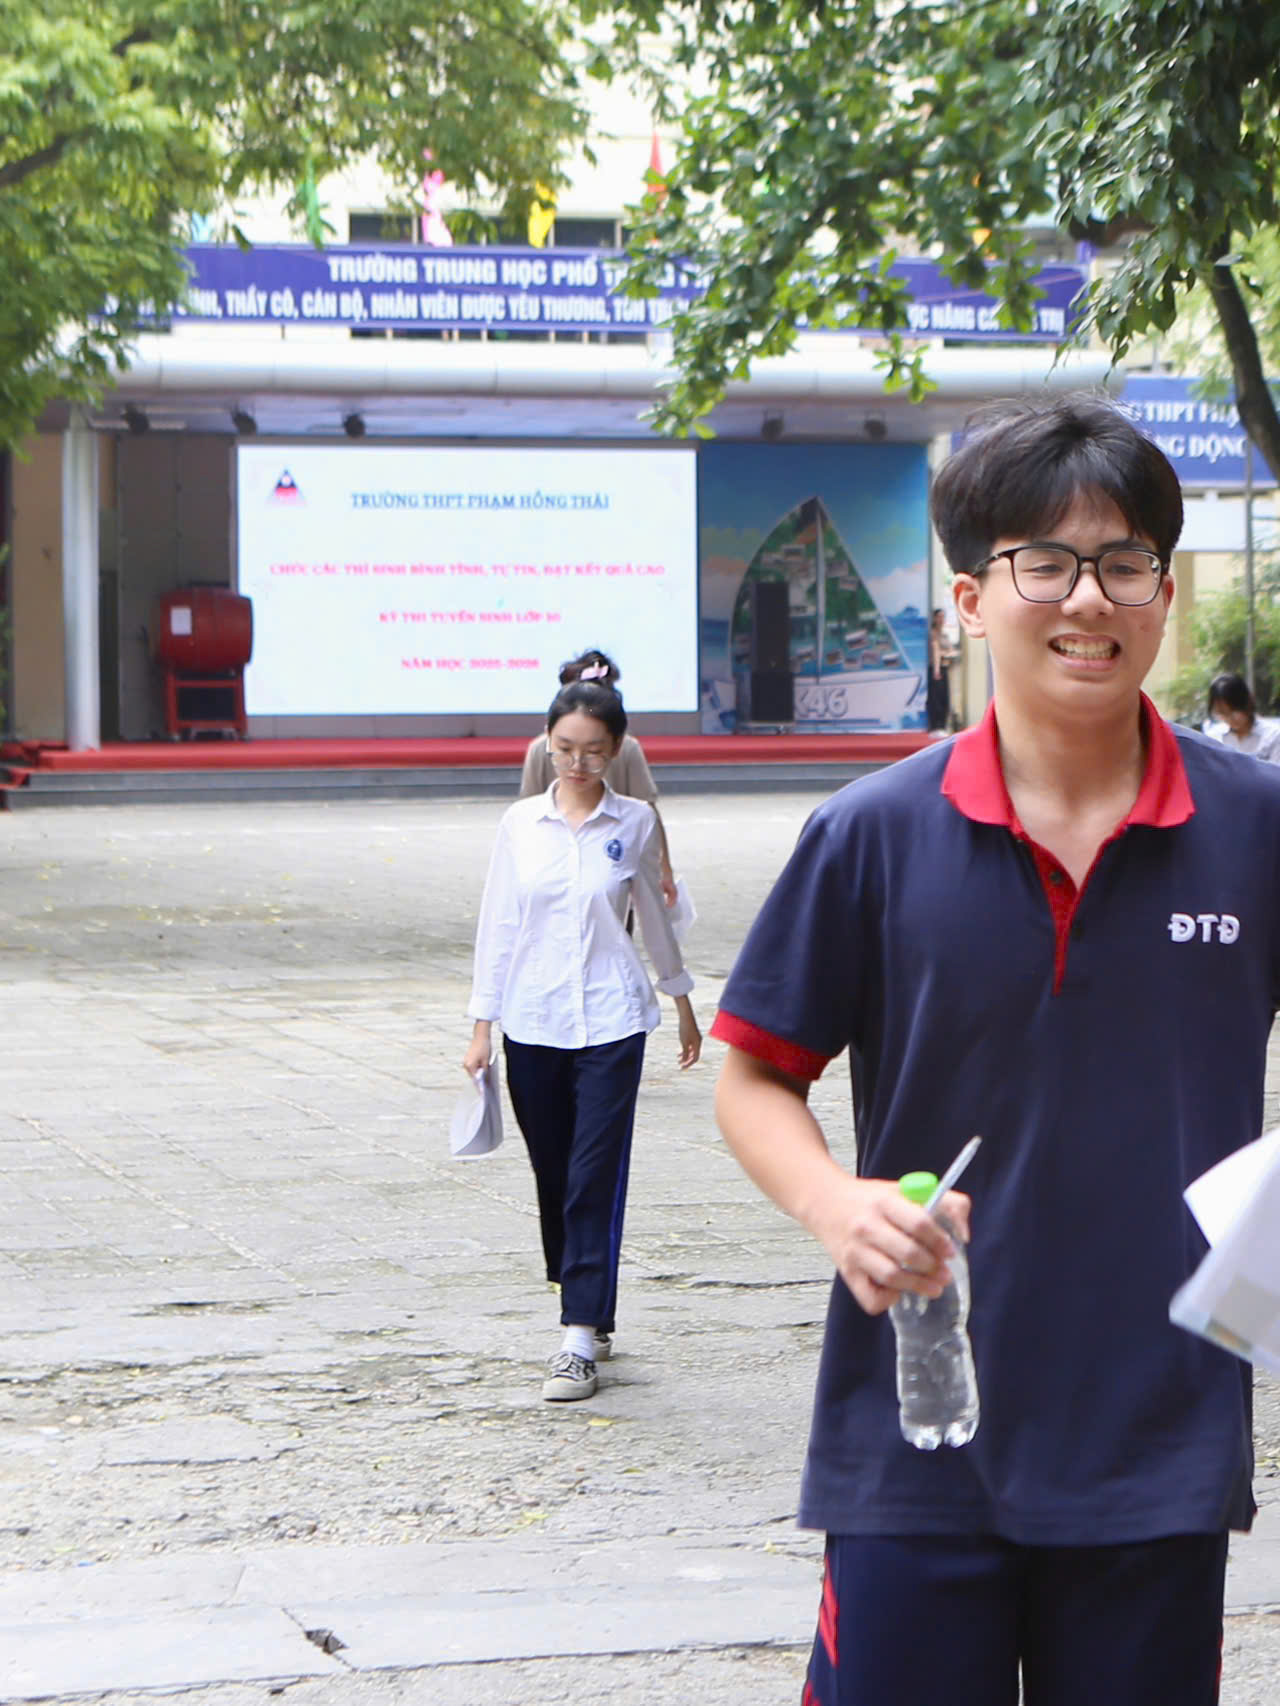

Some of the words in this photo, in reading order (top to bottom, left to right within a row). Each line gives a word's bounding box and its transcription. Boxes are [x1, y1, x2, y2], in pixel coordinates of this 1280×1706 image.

[328, 251, 418, 284] TRƯỜNG
[422, 257, 497, 285] TRUNG
[502, 258, 548, 290] HỌC
[552, 252, 599, 287] PHỔ
[302, 286, 338, 319] CÁN
[371, 287, 418, 320] NHÂN
[420, 289, 459, 320] VIÊN
[508, 290, 540, 321] YÊU
[1144, 401, 1195, 423] THPT
[351, 490, 419, 509] TRƯỜNG
[422, 493, 464, 509] THPT
[467, 494, 515, 511] PHẠM
[519, 489, 568, 509] HỒNG
[571, 491, 610, 509] THÁI
[1168, 912, 1241, 945] ĐTĐ
